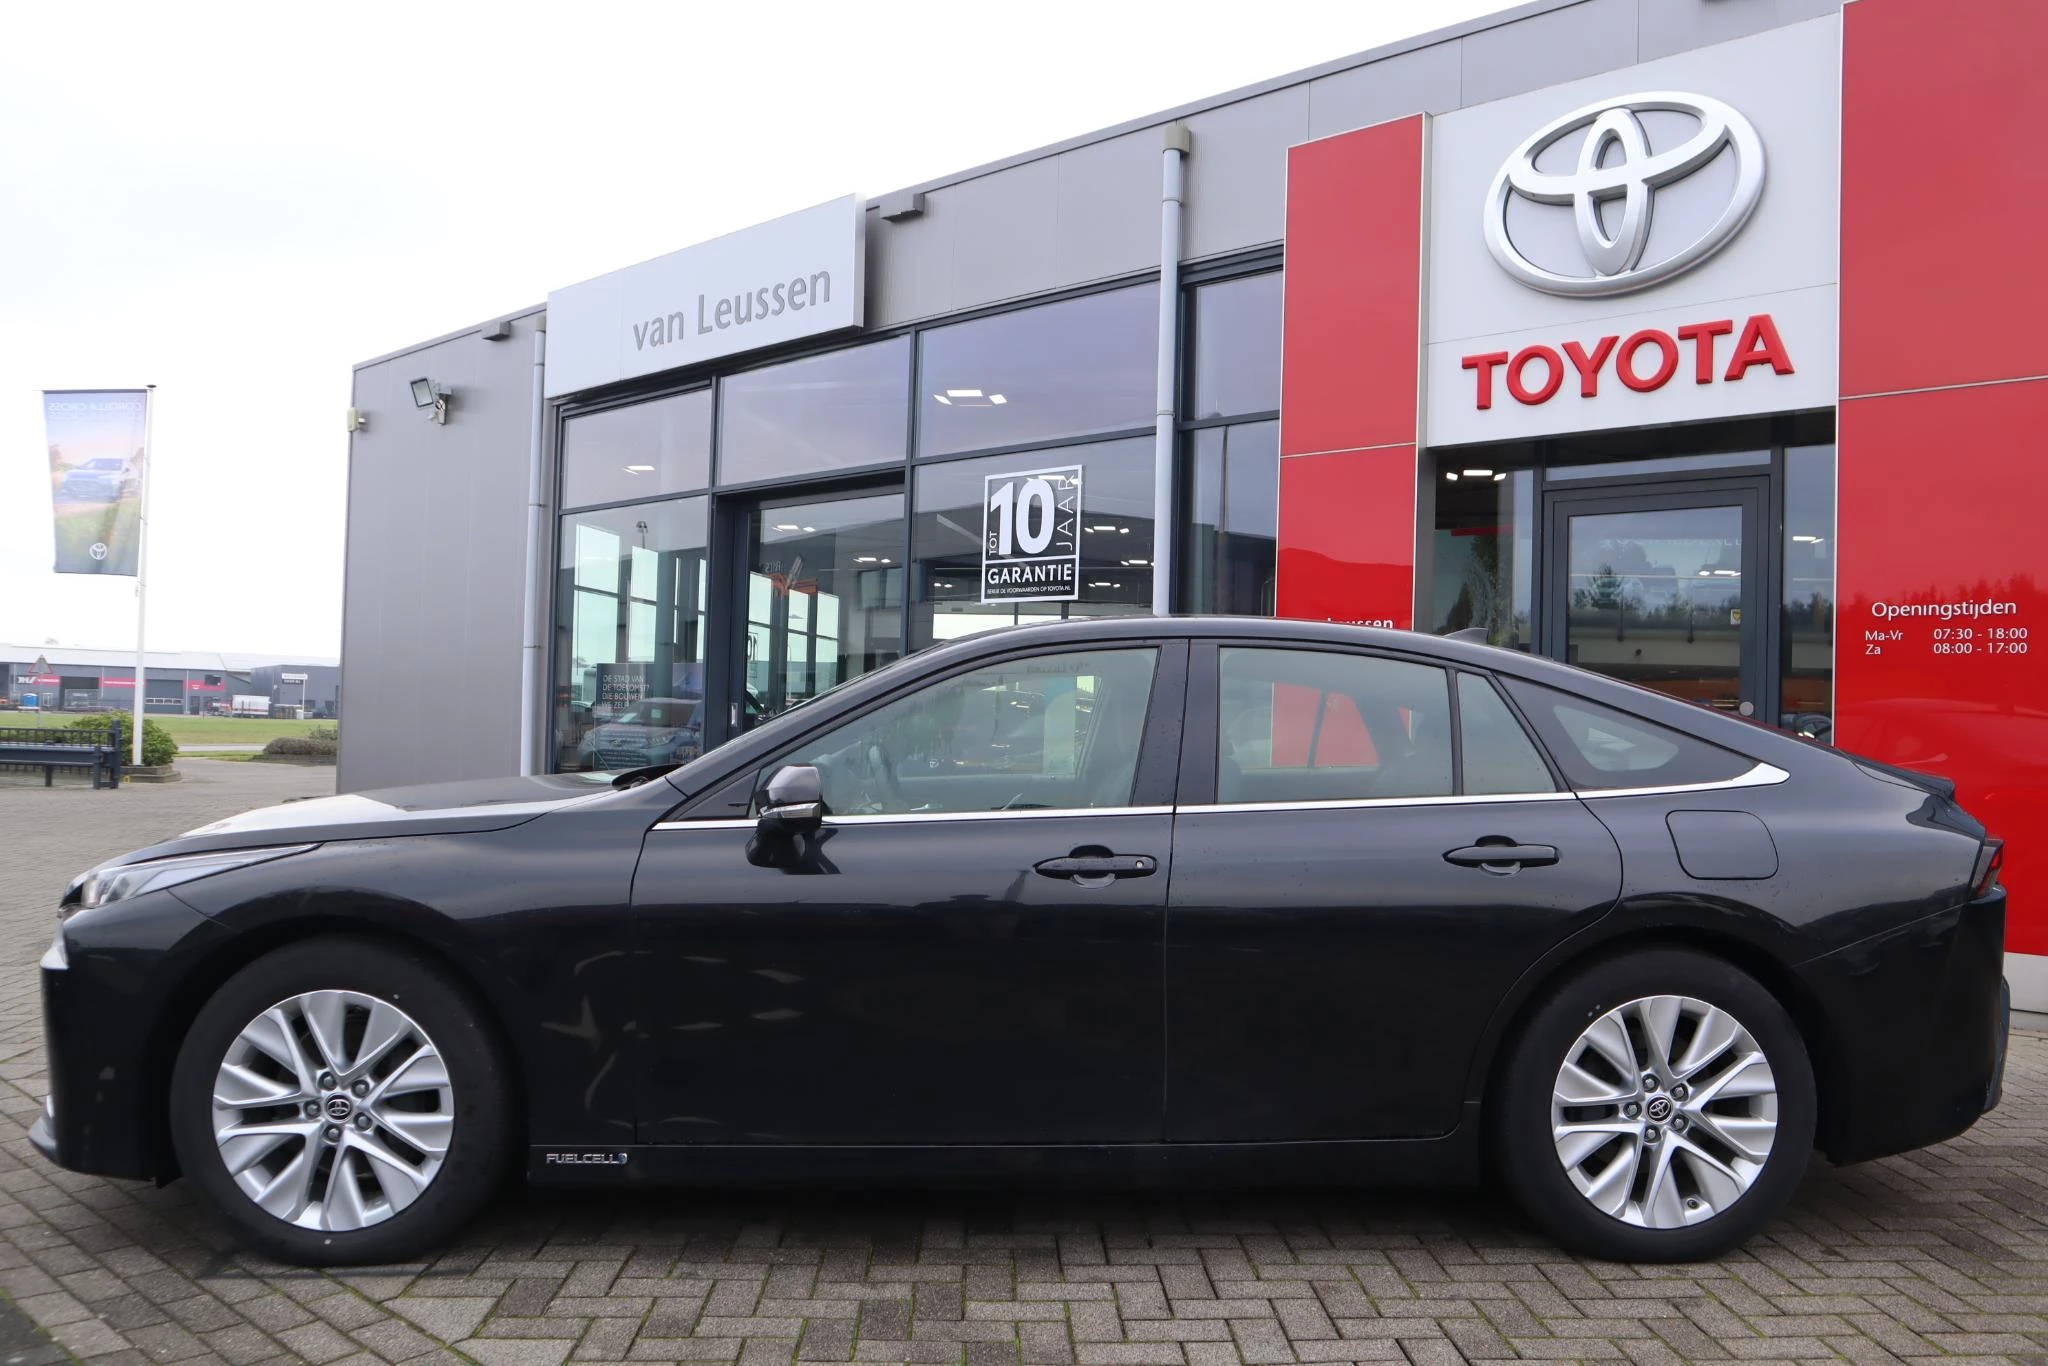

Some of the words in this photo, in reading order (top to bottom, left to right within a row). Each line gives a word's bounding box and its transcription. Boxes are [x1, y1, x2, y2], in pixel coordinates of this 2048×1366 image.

[632, 311, 685, 351] van
[697, 270, 831, 335] Leussen
[1461, 313, 1795, 410] TOYOTA
[990, 478, 1055, 555] 10
[1056, 474, 1075, 551] JAAR
[989, 531, 998, 556] TOT
[987, 563, 1072, 585] GARANTIE
[1871, 598, 2017, 621] Openingstijden
[1865, 629, 1904, 641] Ma-Vr
[1933, 628, 1973, 640] 07:30
[1987, 627, 2028, 640] 18:00
[1865, 644, 1881, 655] Za
[1933, 642, 1973, 654] 08:00
[1987, 642, 2028, 654] 17:00
[546, 1153, 620, 1164] FUELCELL
